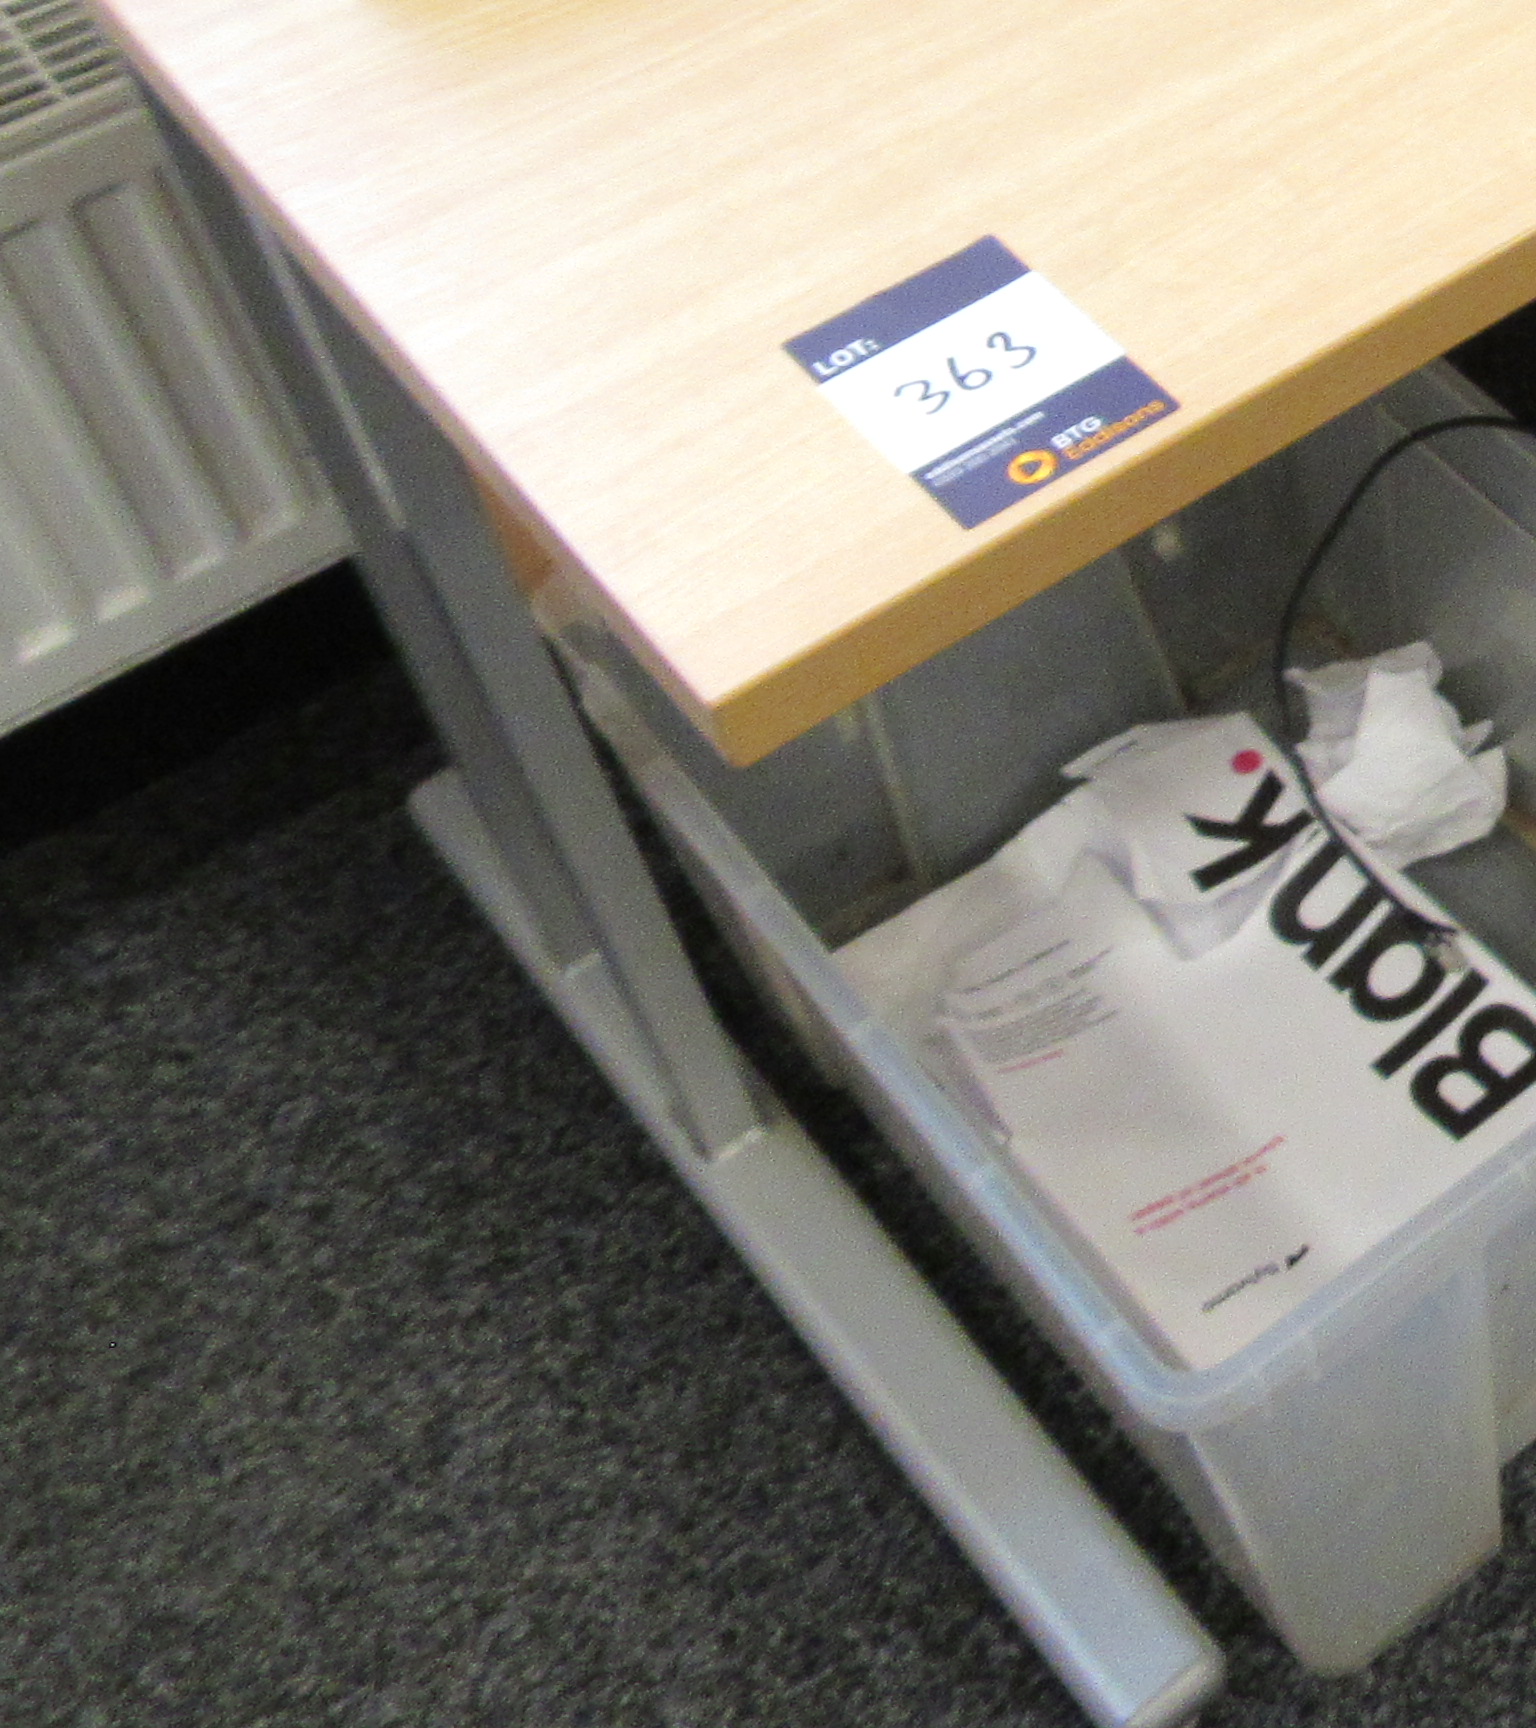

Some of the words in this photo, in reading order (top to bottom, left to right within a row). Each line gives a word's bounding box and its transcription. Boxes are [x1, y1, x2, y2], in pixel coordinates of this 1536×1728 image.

[813, 337, 881, 377] LOT:
[893, 330, 1037, 415] 363
[1050, 415, 1104, 451] BTG
